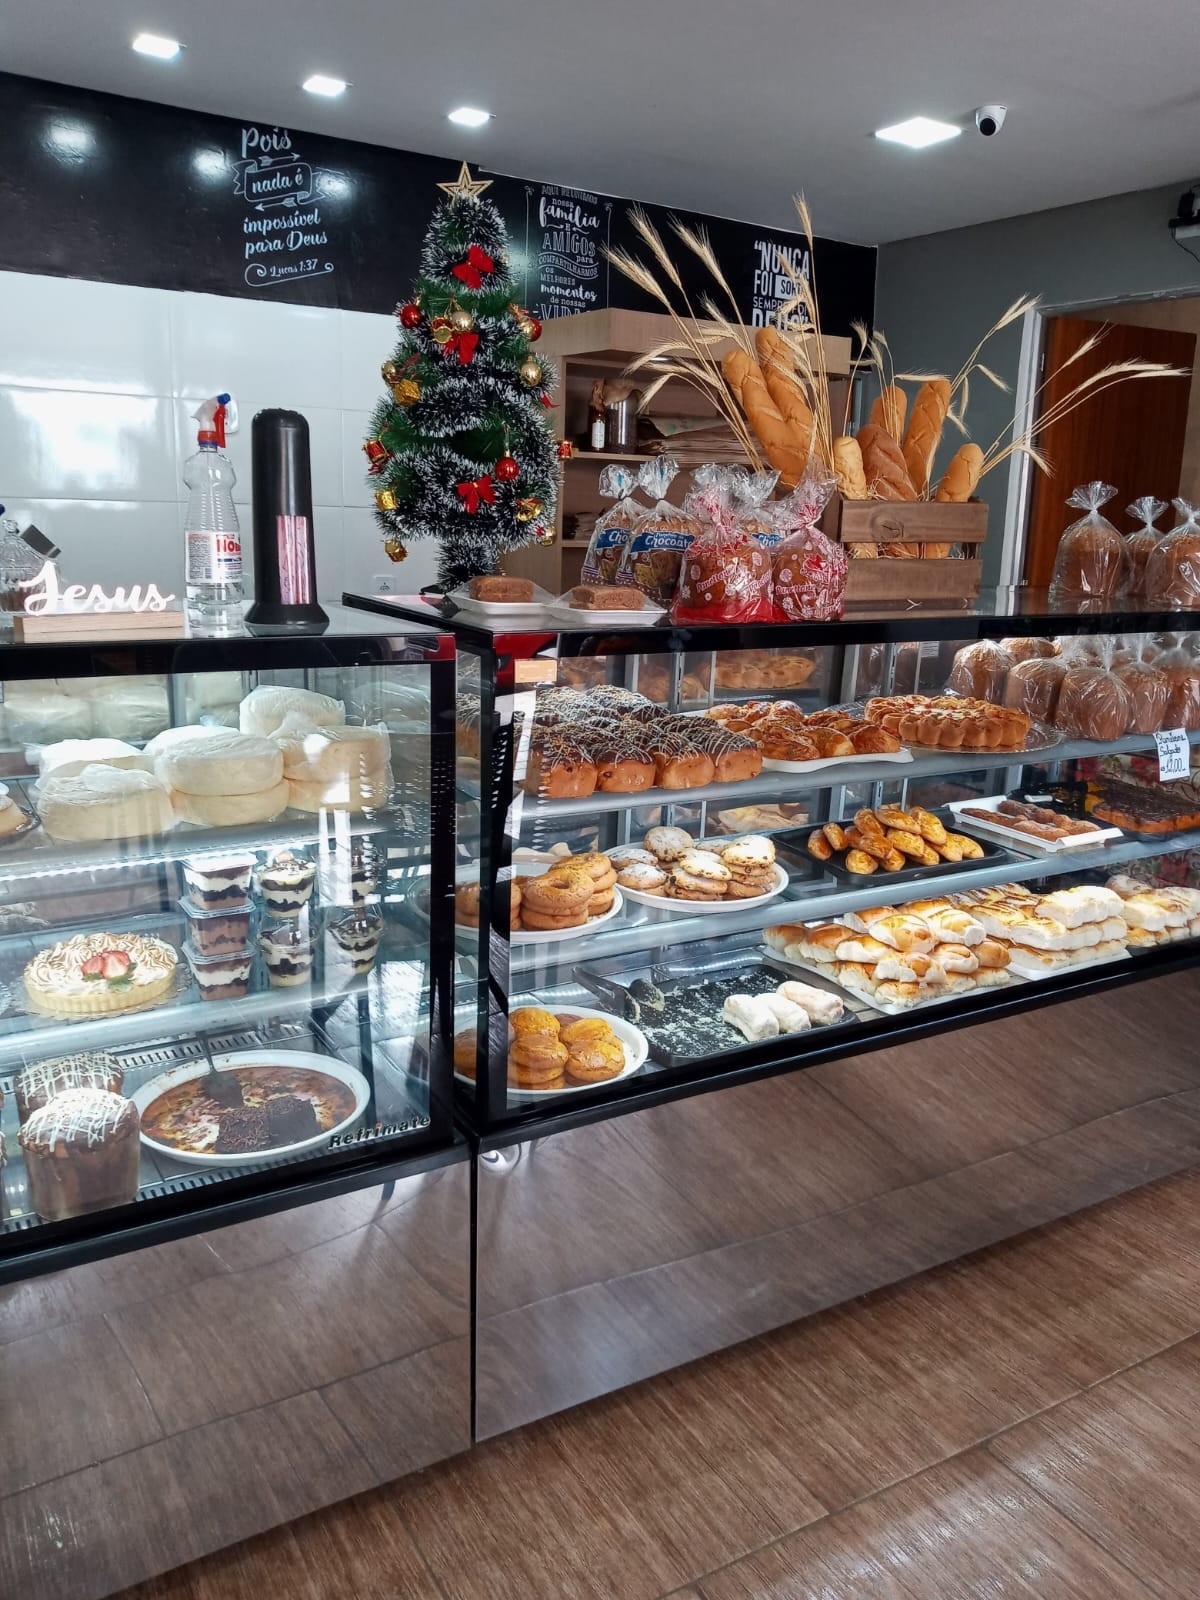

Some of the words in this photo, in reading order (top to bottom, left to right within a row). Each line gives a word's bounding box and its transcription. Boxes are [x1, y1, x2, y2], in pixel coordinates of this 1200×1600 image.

[241, 127, 292, 158] Pois
[252, 172, 293, 194] nada
[294, 168, 303, 185] é
[243, 208, 321, 236] impossível
[244, 238, 285, 259] para
[286, 231, 328, 251] Deus
[542, 231, 596, 257] AMIGOS
[270, 264, 298, 277] Lucas
[299, 258, 319, 273] 1:37
[540, 284, 597, 302] momentos
[753, 269, 773, 297] FOI
[18, 559, 176, 616] Jesus
